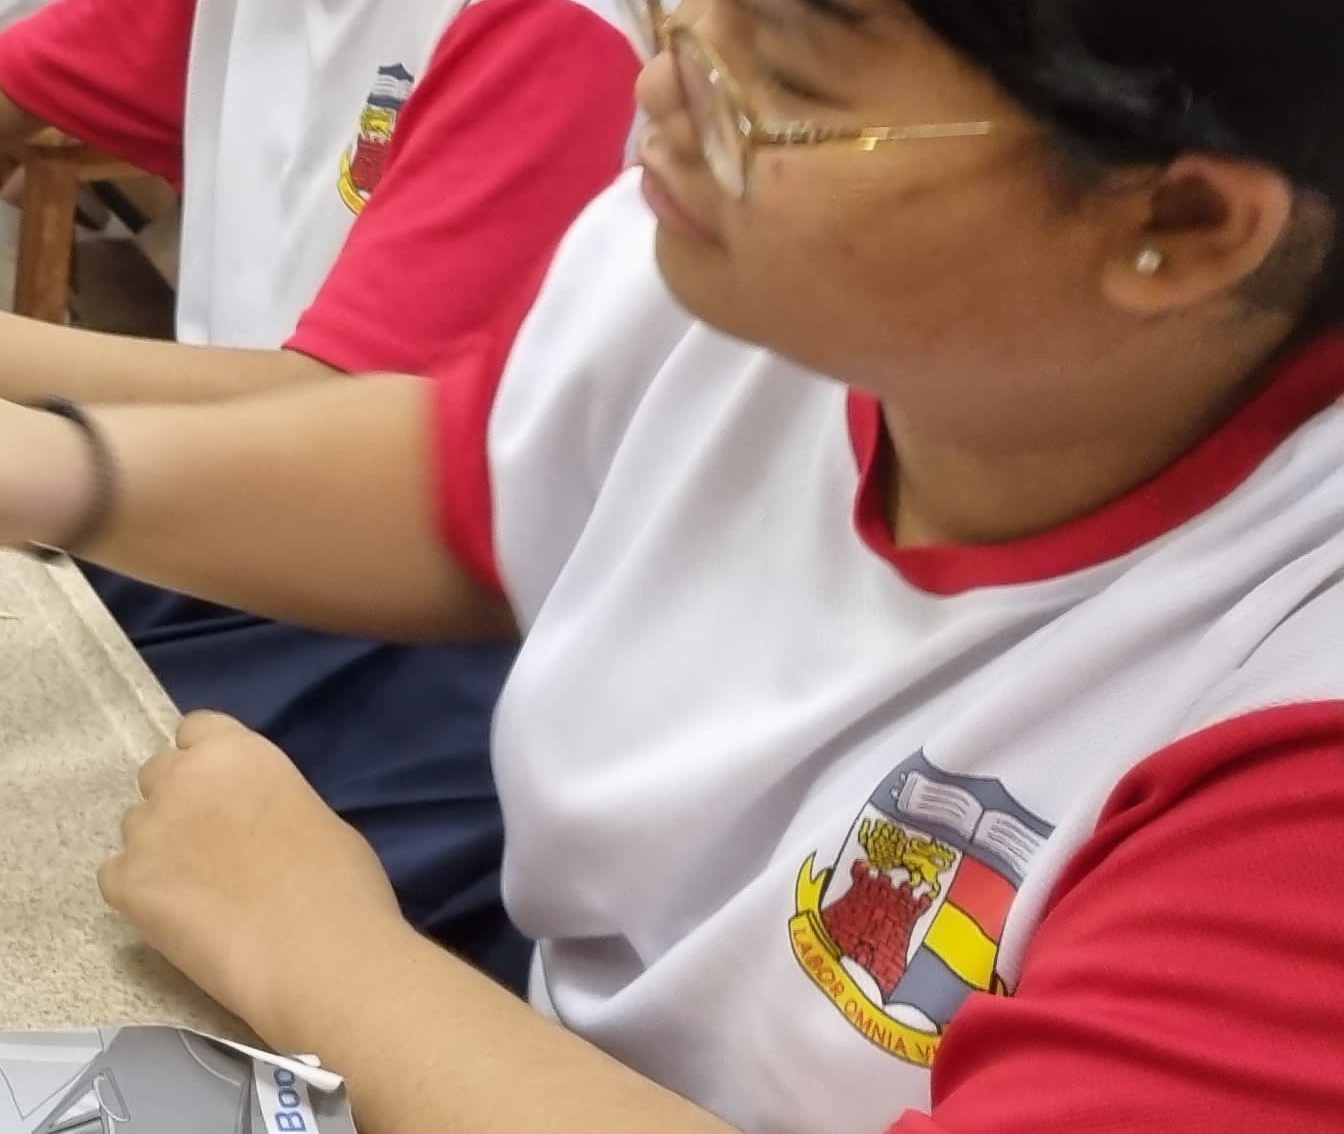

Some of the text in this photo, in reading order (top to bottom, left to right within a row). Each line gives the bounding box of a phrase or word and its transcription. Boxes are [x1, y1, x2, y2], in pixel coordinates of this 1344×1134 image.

[793, 929, 844, 998] LABOR
[844, 999, 907, 1055] OMNIA
[273, 1068, 307, 1132] Boo
